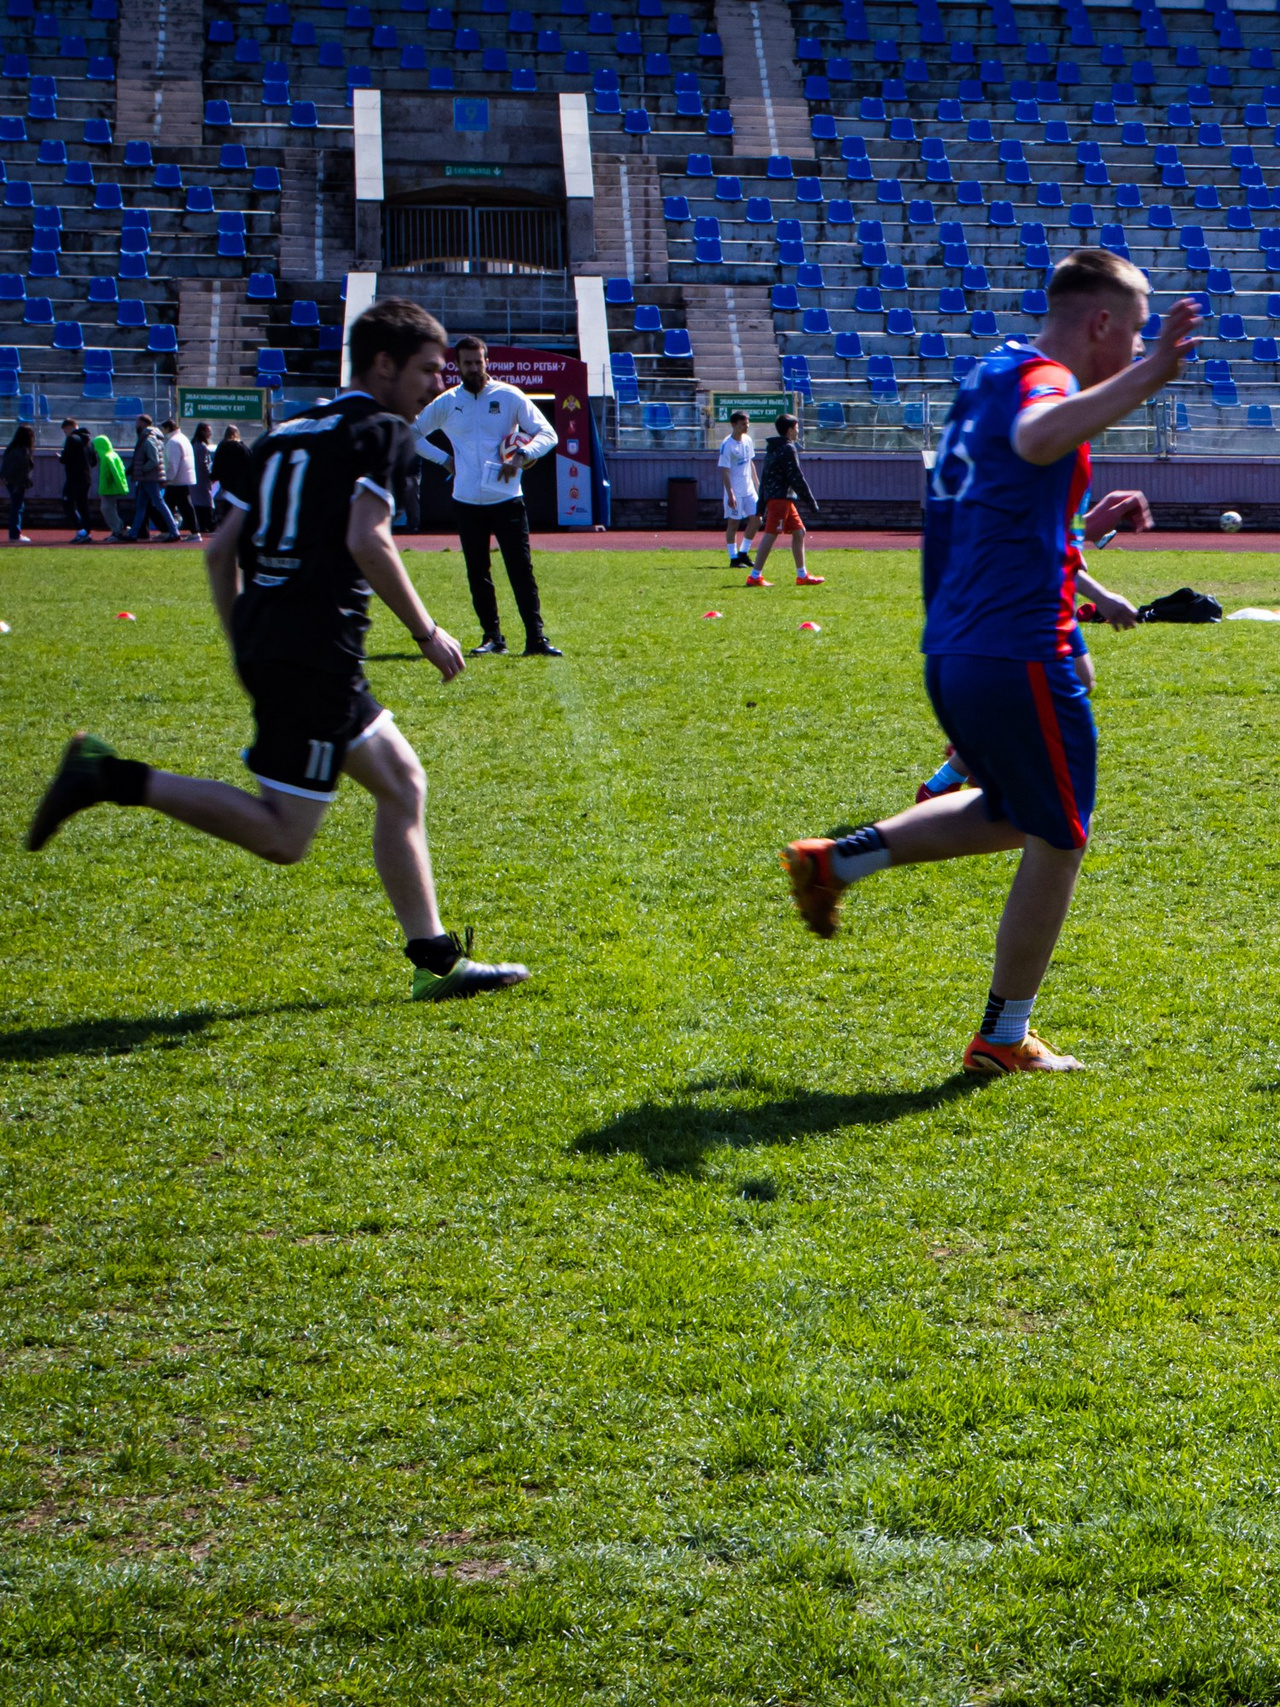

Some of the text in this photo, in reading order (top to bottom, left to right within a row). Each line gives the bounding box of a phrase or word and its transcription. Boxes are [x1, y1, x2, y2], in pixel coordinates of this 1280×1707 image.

[485, 362, 566, 371] УРНИР ПО РЕГБИ-7
[252, 449, 310, 551] 11
[305, 739, 335, 781] 11
